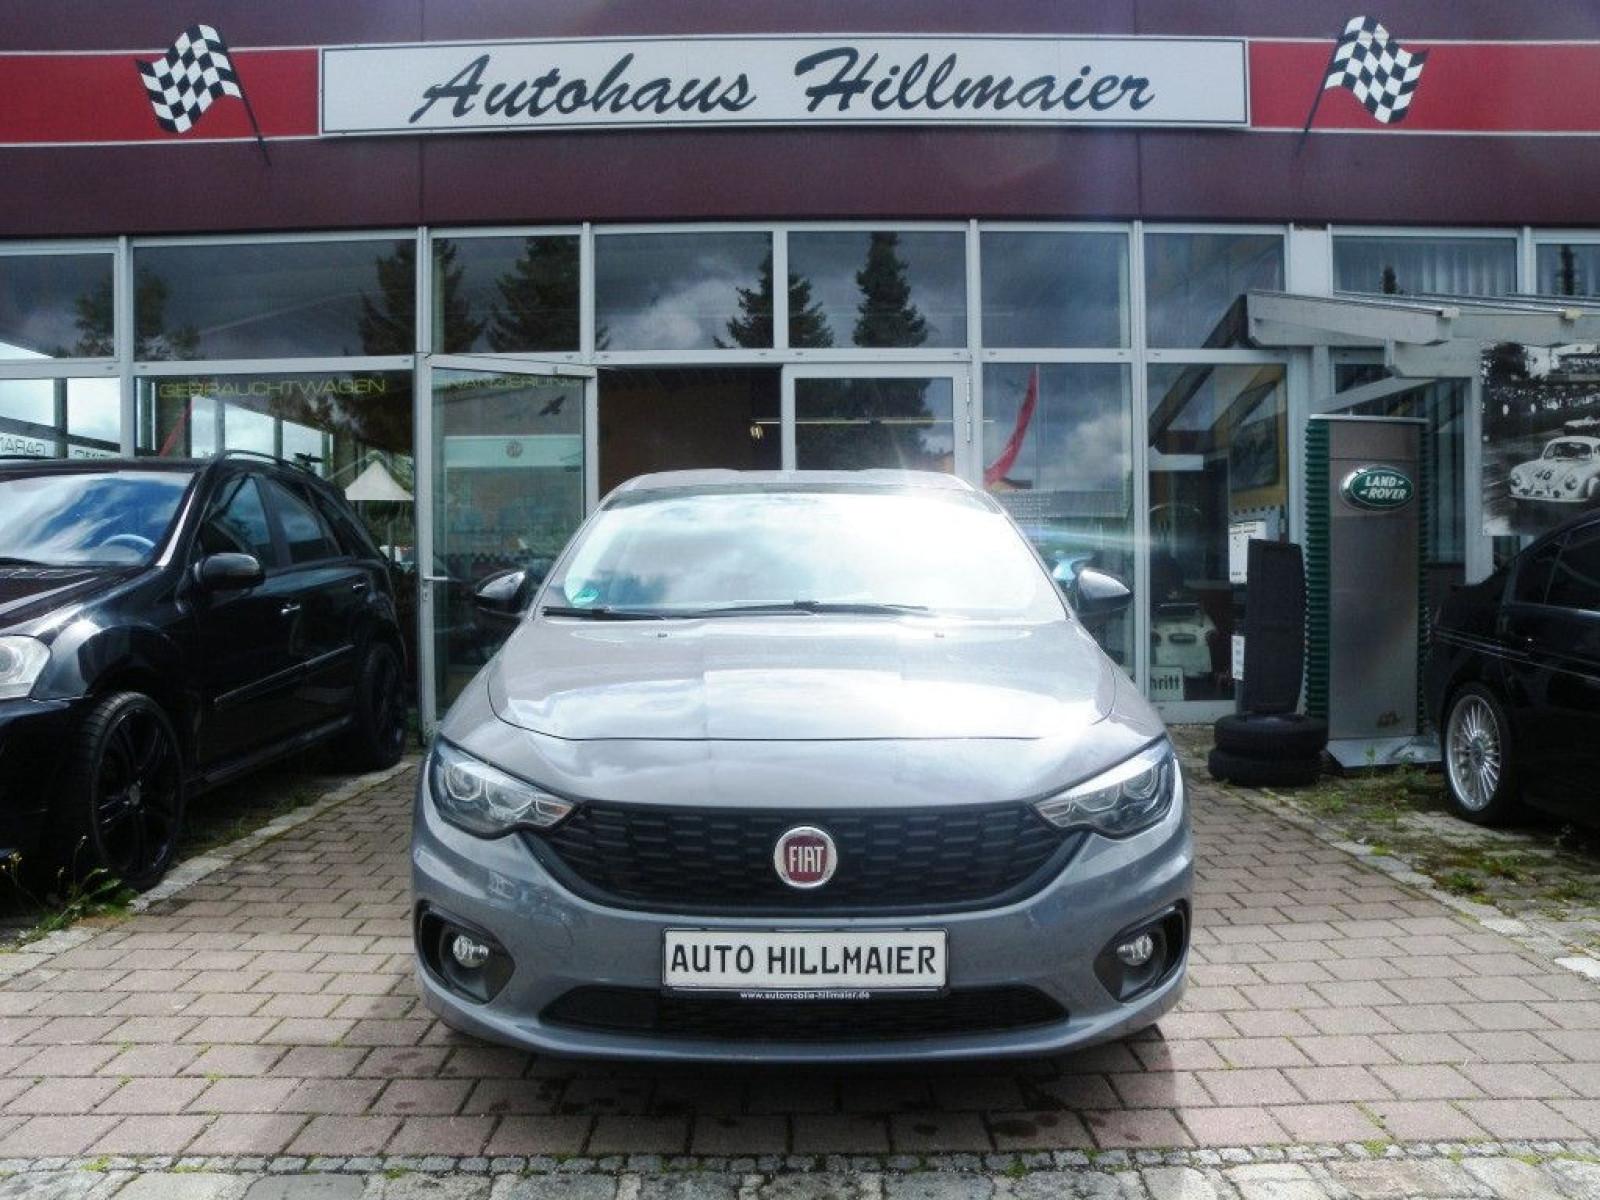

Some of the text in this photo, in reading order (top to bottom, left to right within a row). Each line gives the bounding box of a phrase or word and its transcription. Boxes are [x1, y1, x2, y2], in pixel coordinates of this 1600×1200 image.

[410, 46, 1155, 122] Autohaus Hillmaier
[159, 378, 386, 398] GEBRAUCHTWAGEN
[788, 845, 824, 873] FIAT
[671, 943, 936, 975] AUTO HILLMAIER
